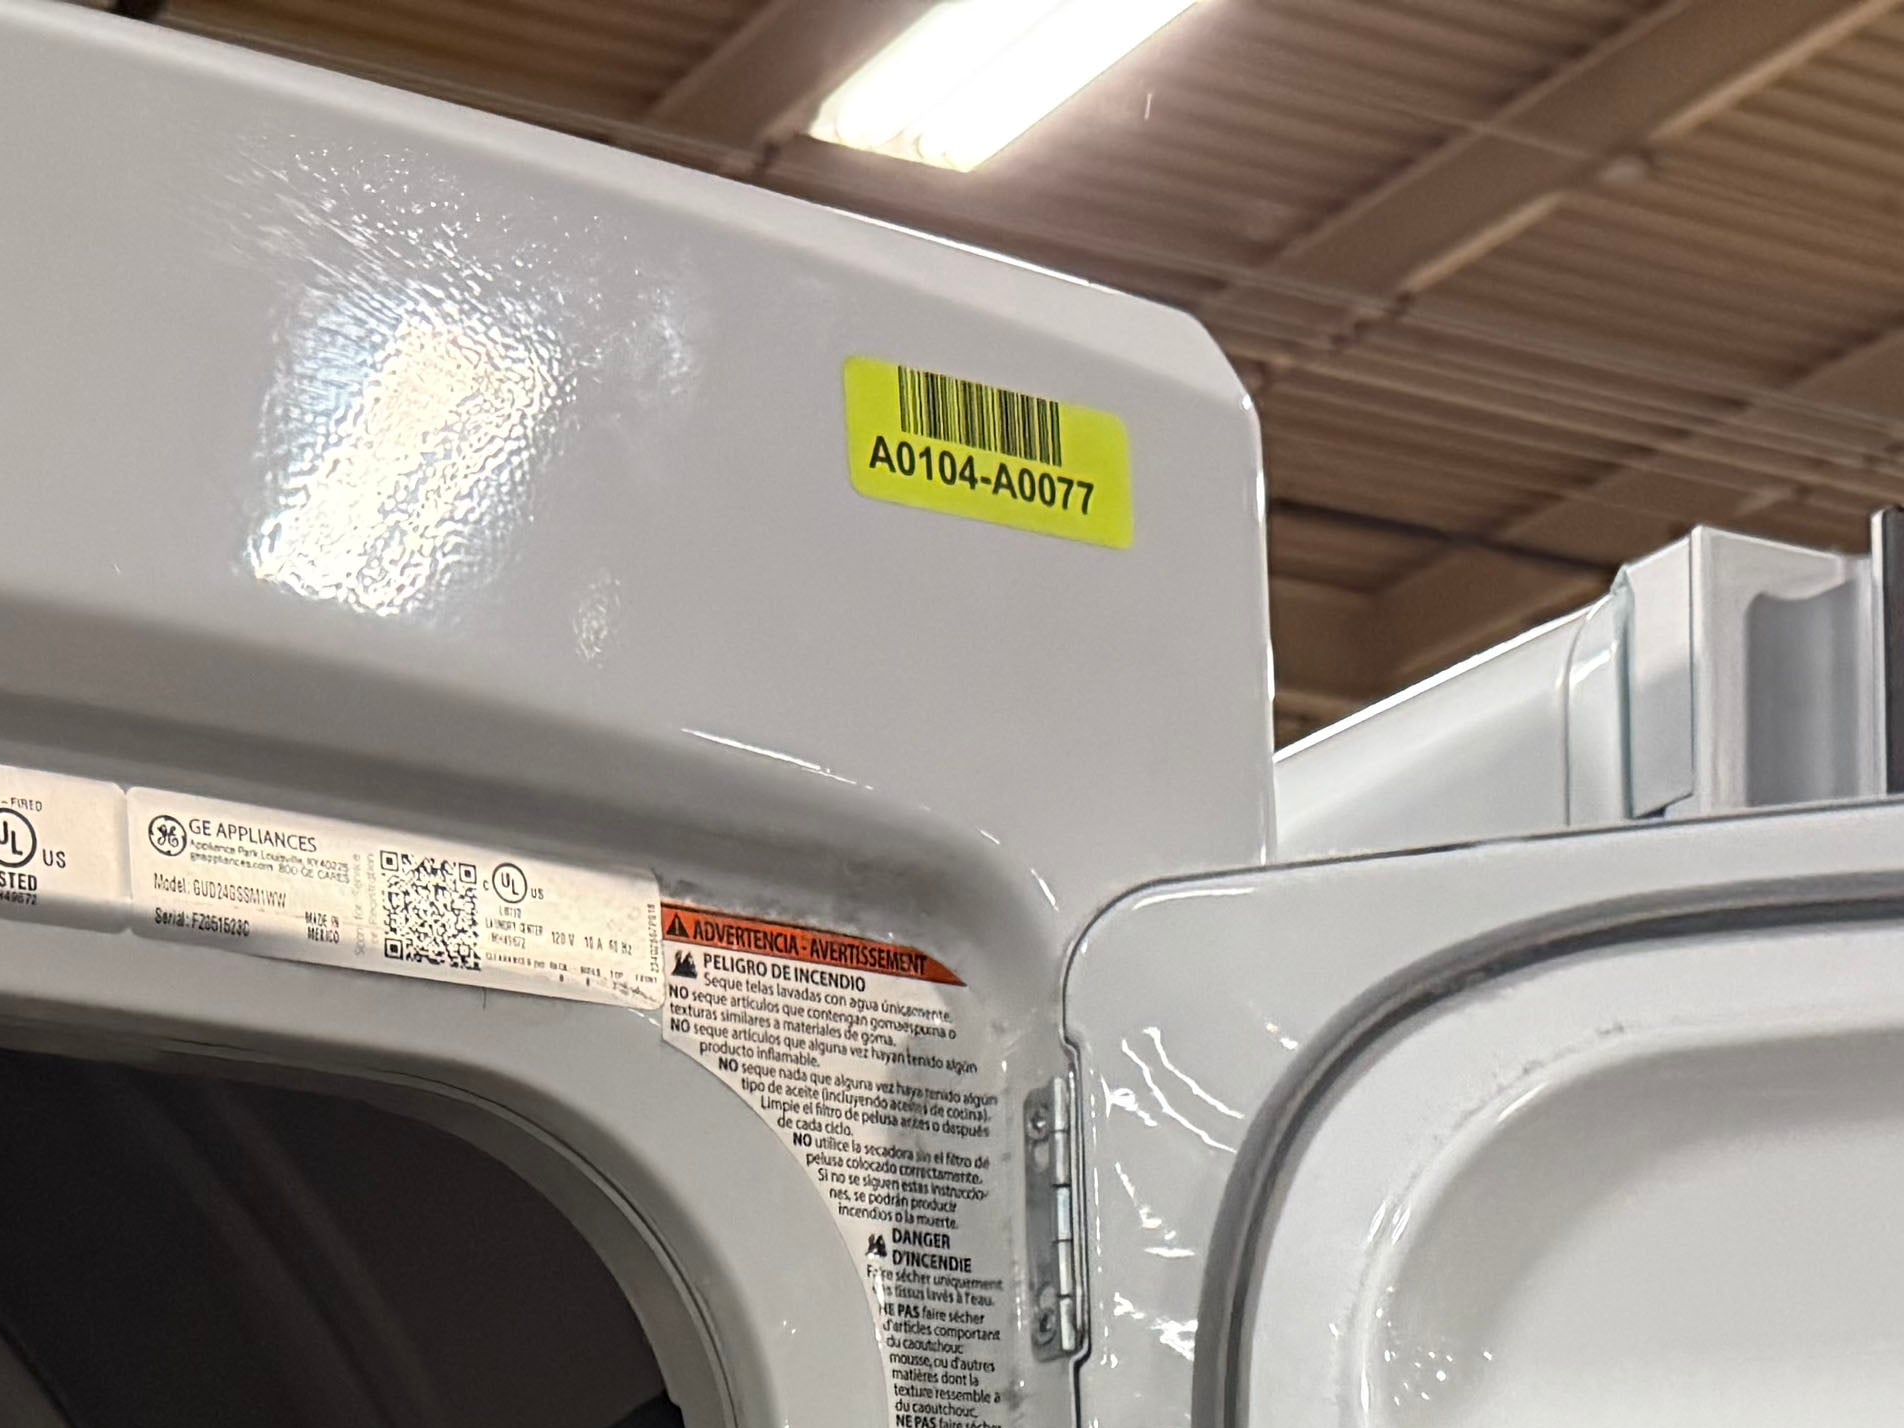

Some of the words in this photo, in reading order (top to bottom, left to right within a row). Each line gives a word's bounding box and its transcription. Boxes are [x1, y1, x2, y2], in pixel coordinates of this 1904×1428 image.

[869, 436, 1094, 515] A0104-A0077
[189, 818, 211, 837] GE
[217, 823, 317, 852] APPLIANCES
[43, 849, 66, 868] US
[694, 920, 798, 955] ADVERTENCIA
[811, 938, 927, 975] AVERTISSEMENT
[703, 952, 767, 977] PELIGRO
[772, 964, 791, 981] DE
[795, 967, 866, 992] INCENDIO
[669, 984, 689, 999] NO
[692, 990, 726, 1006] seque
[730, 996, 779, 1013] artículos
[782, 1005, 804, 1017] que
[704, 973, 743, 992] Seque
[746, 980, 774, 996] telas
[777, 983, 821, 1004] lavadas
[670, 1018, 690, 1032] NO
[718, 1057, 738, 1072] NO
[892, 1228, 950, 1249] DANGER
